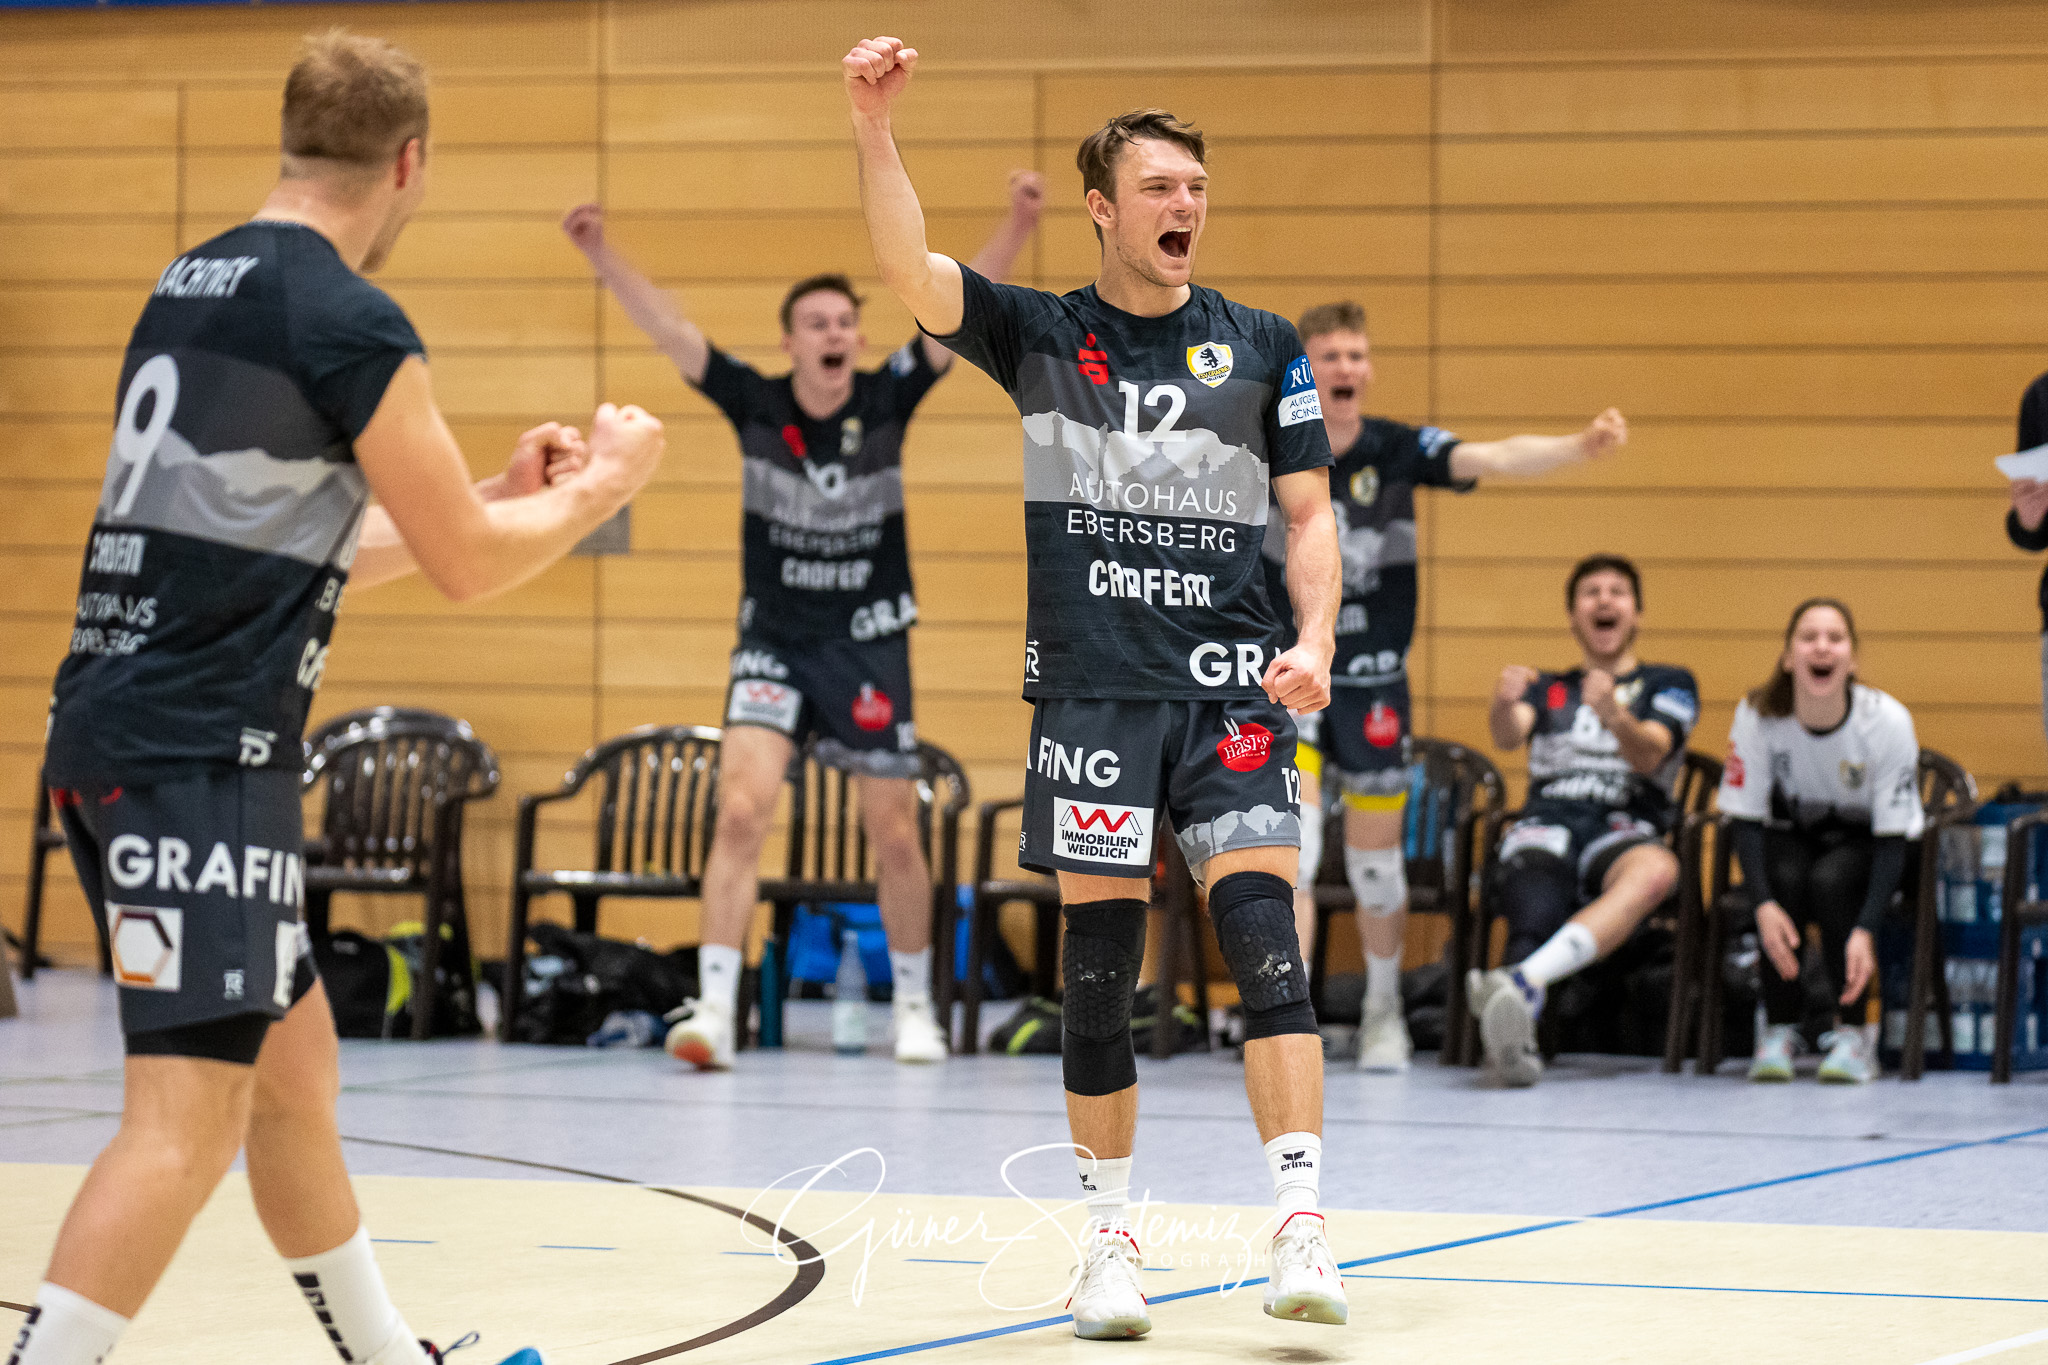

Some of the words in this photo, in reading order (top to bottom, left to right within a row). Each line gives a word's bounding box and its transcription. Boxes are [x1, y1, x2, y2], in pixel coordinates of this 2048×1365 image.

[1290, 358, 1314, 388] RÜ
[1119, 380, 1186, 442] 12
[115, 354, 180, 517] 9
[1069, 472, 1237, 516] AUTOHAUS
[1067, 509, 1236, 552] EBERSBERG
[1189, 642, 1280, 687] GR
[1281, 767, 1301, 805] 12
[1061, 829, 1139, 849] IMMOBILIEN
[1067, 842, 1129, 860] WEIDLICH
[1281, 1160, 1313, 1172] erima
